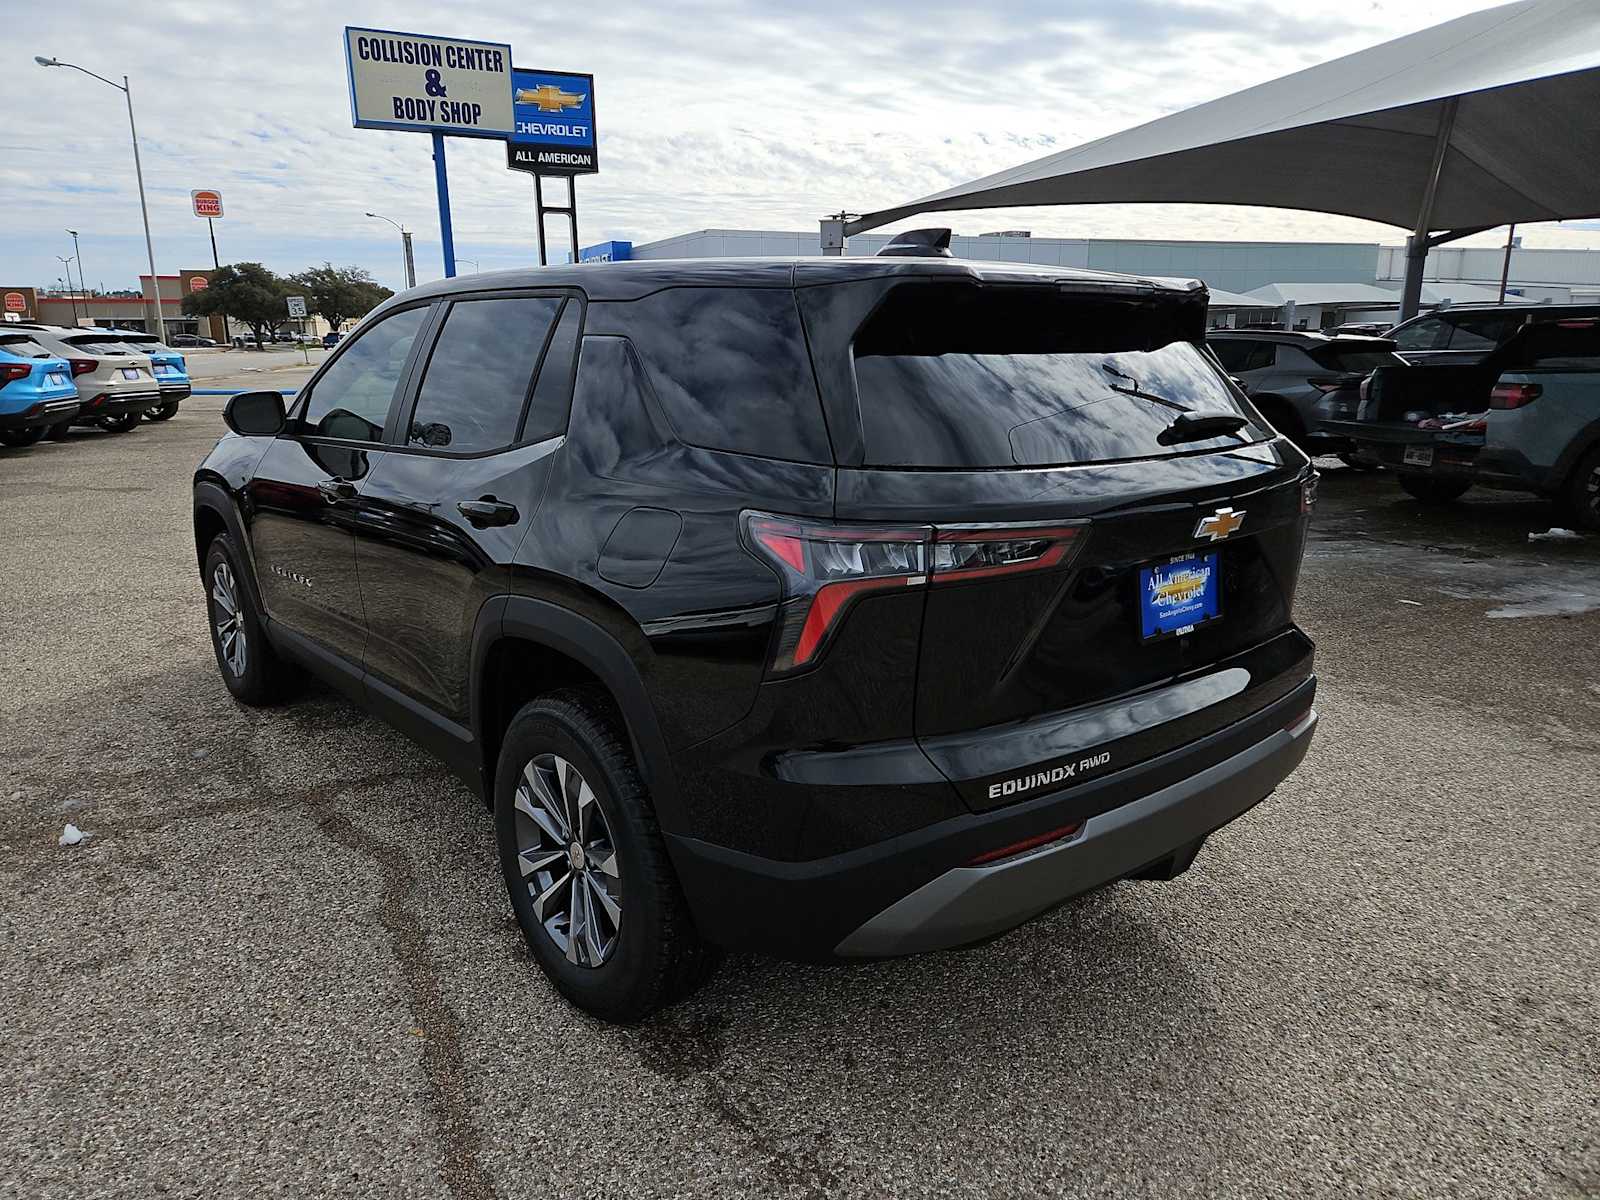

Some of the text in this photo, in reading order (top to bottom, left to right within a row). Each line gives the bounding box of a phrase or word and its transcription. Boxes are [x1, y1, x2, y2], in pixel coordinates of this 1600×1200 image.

[357, 36, 504, 73] COLLISION CENTER
[425, 68, 447, 98] &
[393, 96, 481, 125] BODY SHOP
[515, 150, 592, 166] ALL AMERICAN
[291, 307, 305, 315] 35
[1147, 566, 1211, 591] All American
[1157, 584, 1205, 606] Chevrolet
[988, 751, 1110, 799] EQUINOX AWD
